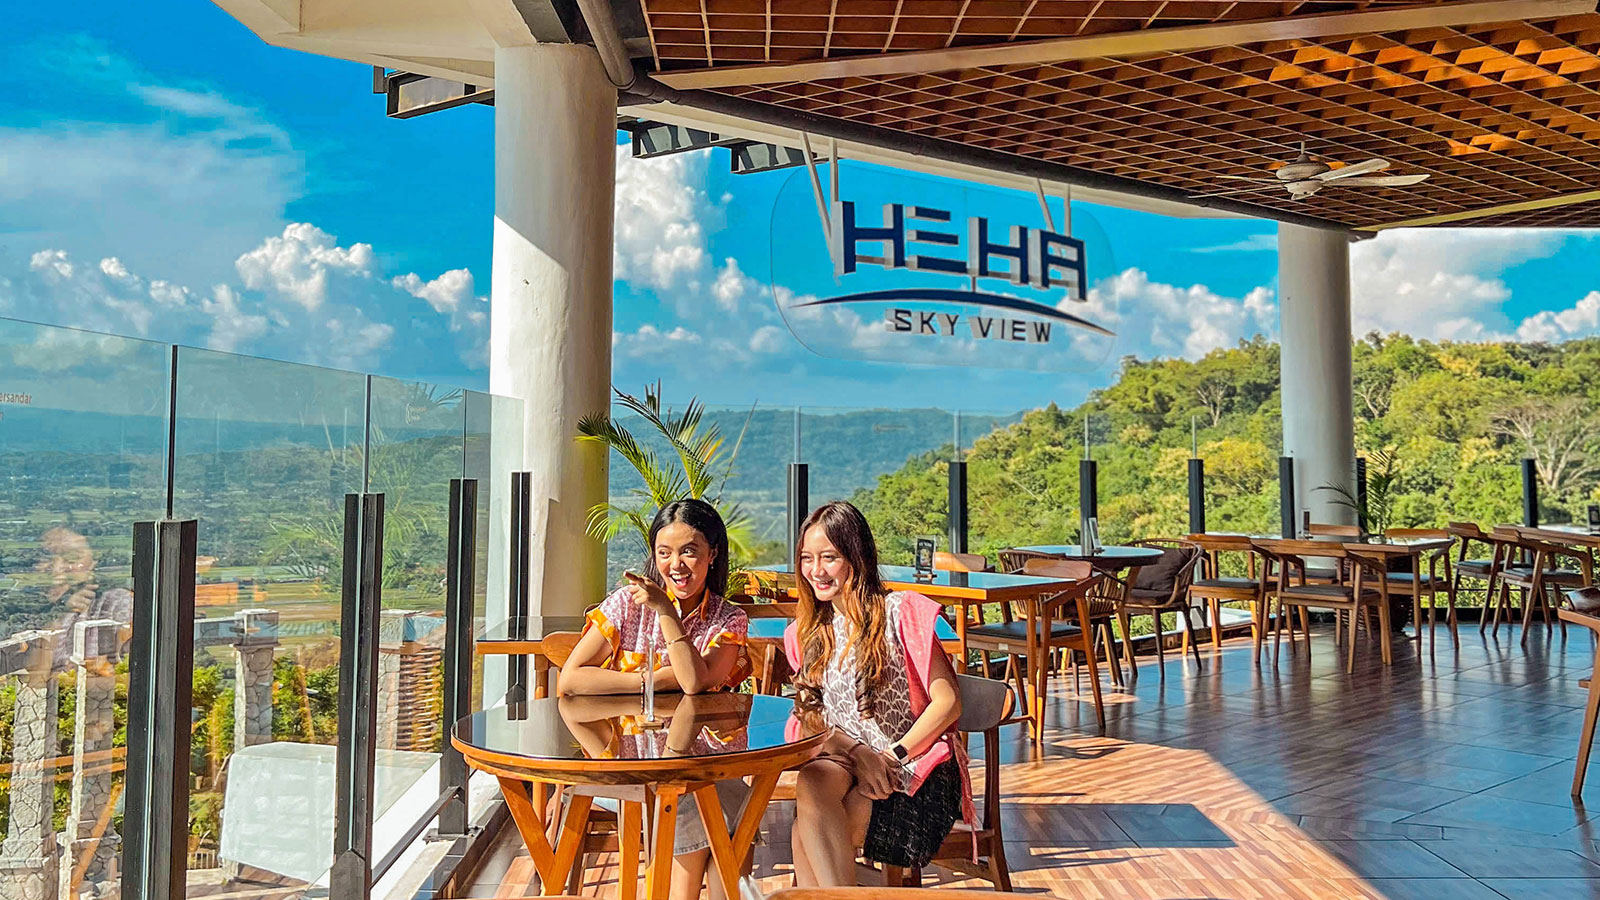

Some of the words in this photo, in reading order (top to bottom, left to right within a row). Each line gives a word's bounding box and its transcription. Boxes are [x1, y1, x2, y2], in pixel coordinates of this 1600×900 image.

[833, 200, 1088, 302] HEHA
[886, 308, 960, 336] SKY
[968, 316, 1051, 343] VIEW
